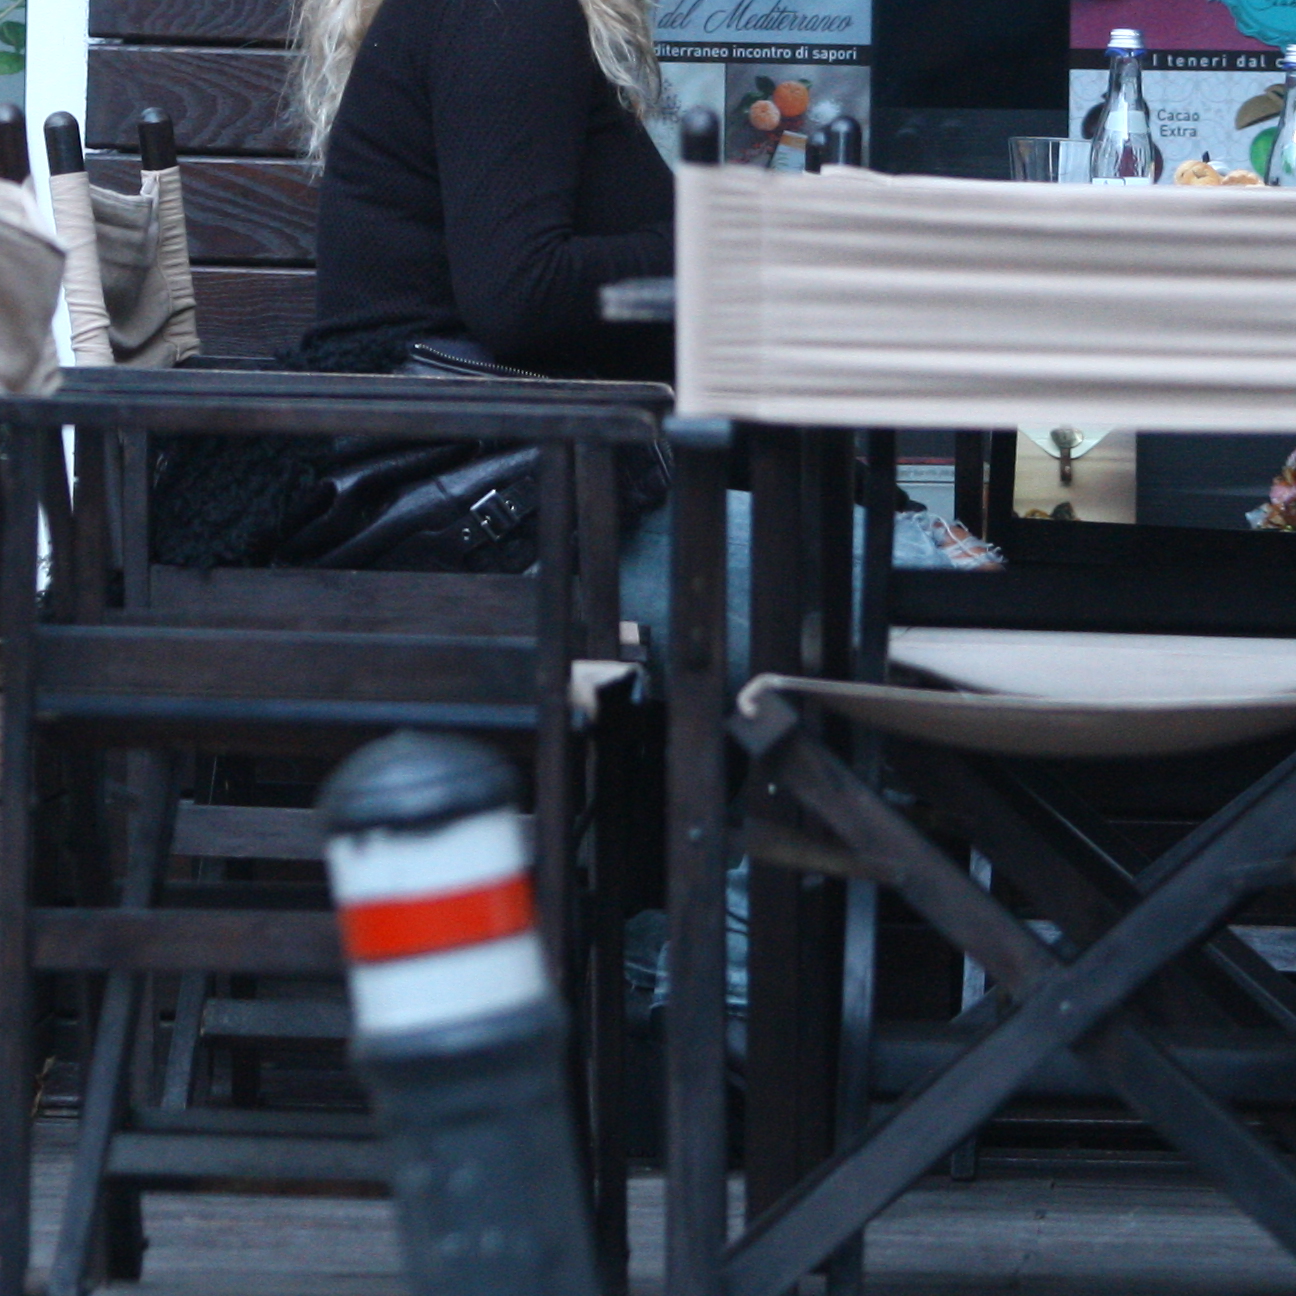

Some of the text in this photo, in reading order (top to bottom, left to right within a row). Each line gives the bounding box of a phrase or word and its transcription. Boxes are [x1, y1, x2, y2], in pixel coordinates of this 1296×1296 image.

[732, 44, 791, 60] incontro
[795, 46, 809, 60] di
[812, 47, 857, 63] sapori
[1167, 55, 1227, 68] teneri
[1236, 55, 1266, 68] dal
[1156, 108, 1200, 122] Cacao
[1159, 123, 1198, 138] Extra
